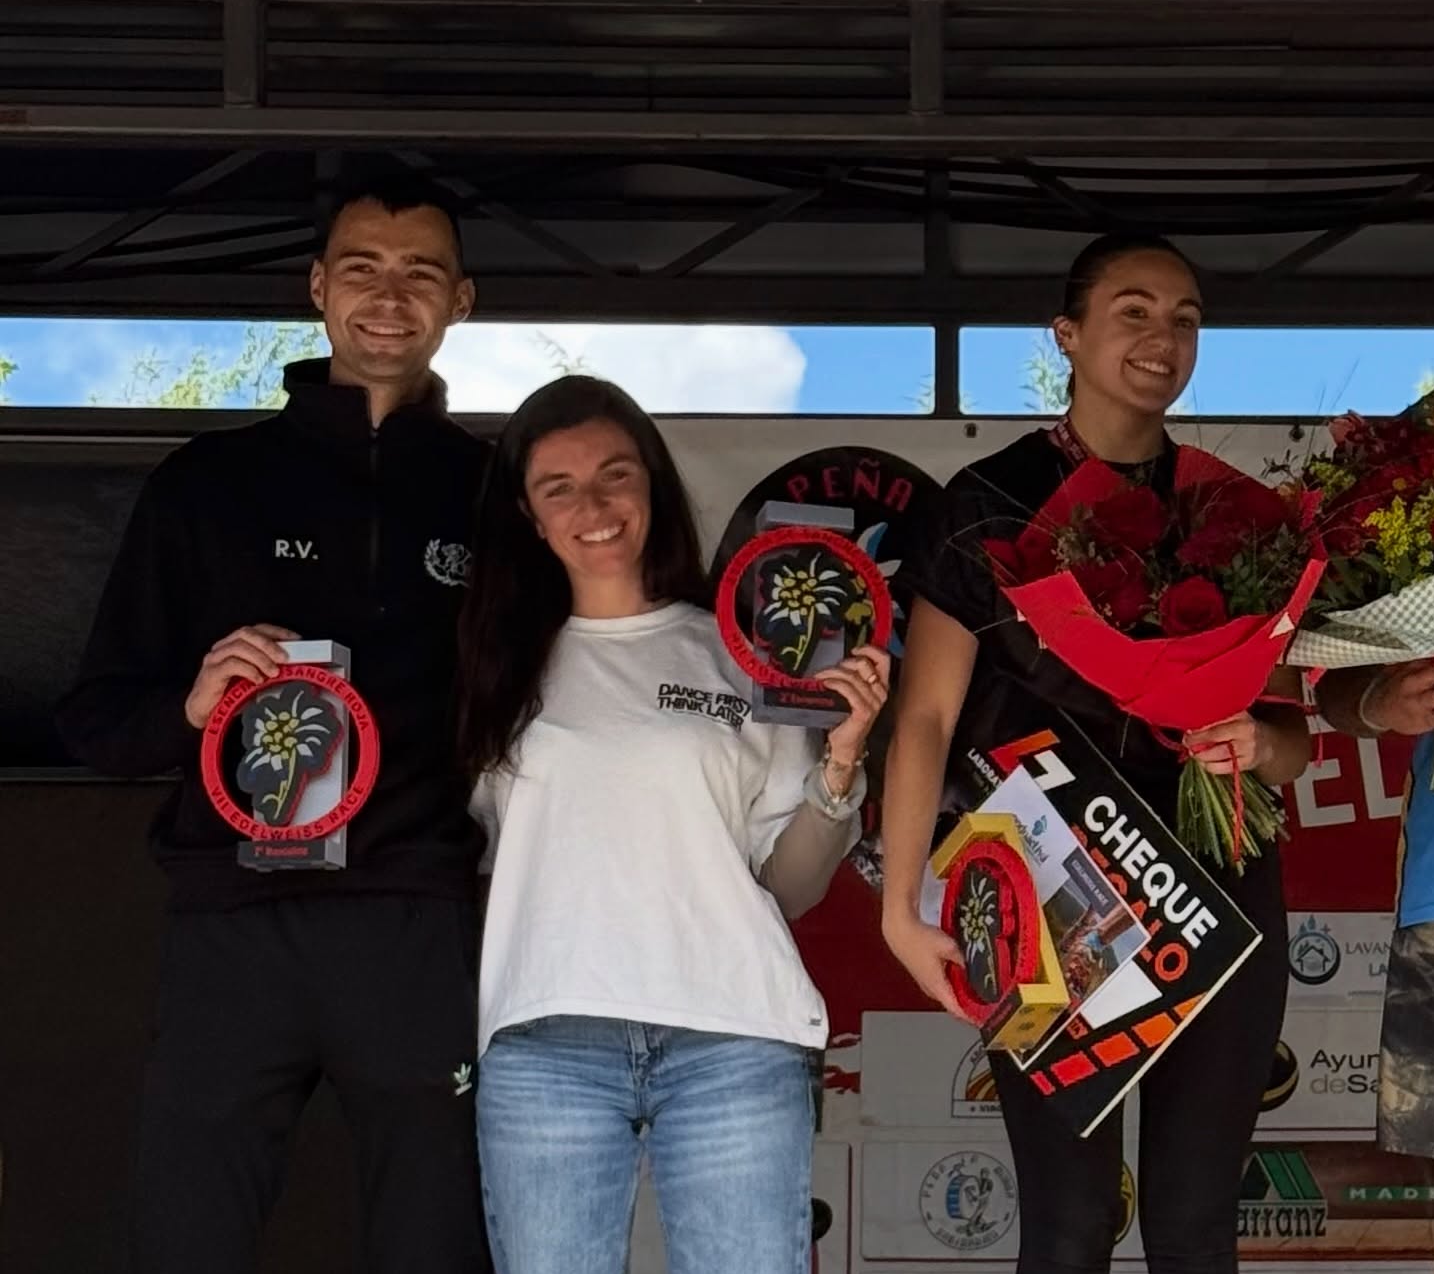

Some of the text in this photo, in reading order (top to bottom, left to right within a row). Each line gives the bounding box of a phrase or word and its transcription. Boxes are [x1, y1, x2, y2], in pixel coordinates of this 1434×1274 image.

[786, 457, 914, 512] PEÑA
[275, 539, 319, 560] R.V.
[658, 683, 752, 717] DANCE FIRST
[658, 696, 744, 732] THINK LATER
[967, 748, 1002, 788] LABORA
[1084, 796, 1219, 949] CHEQUE
